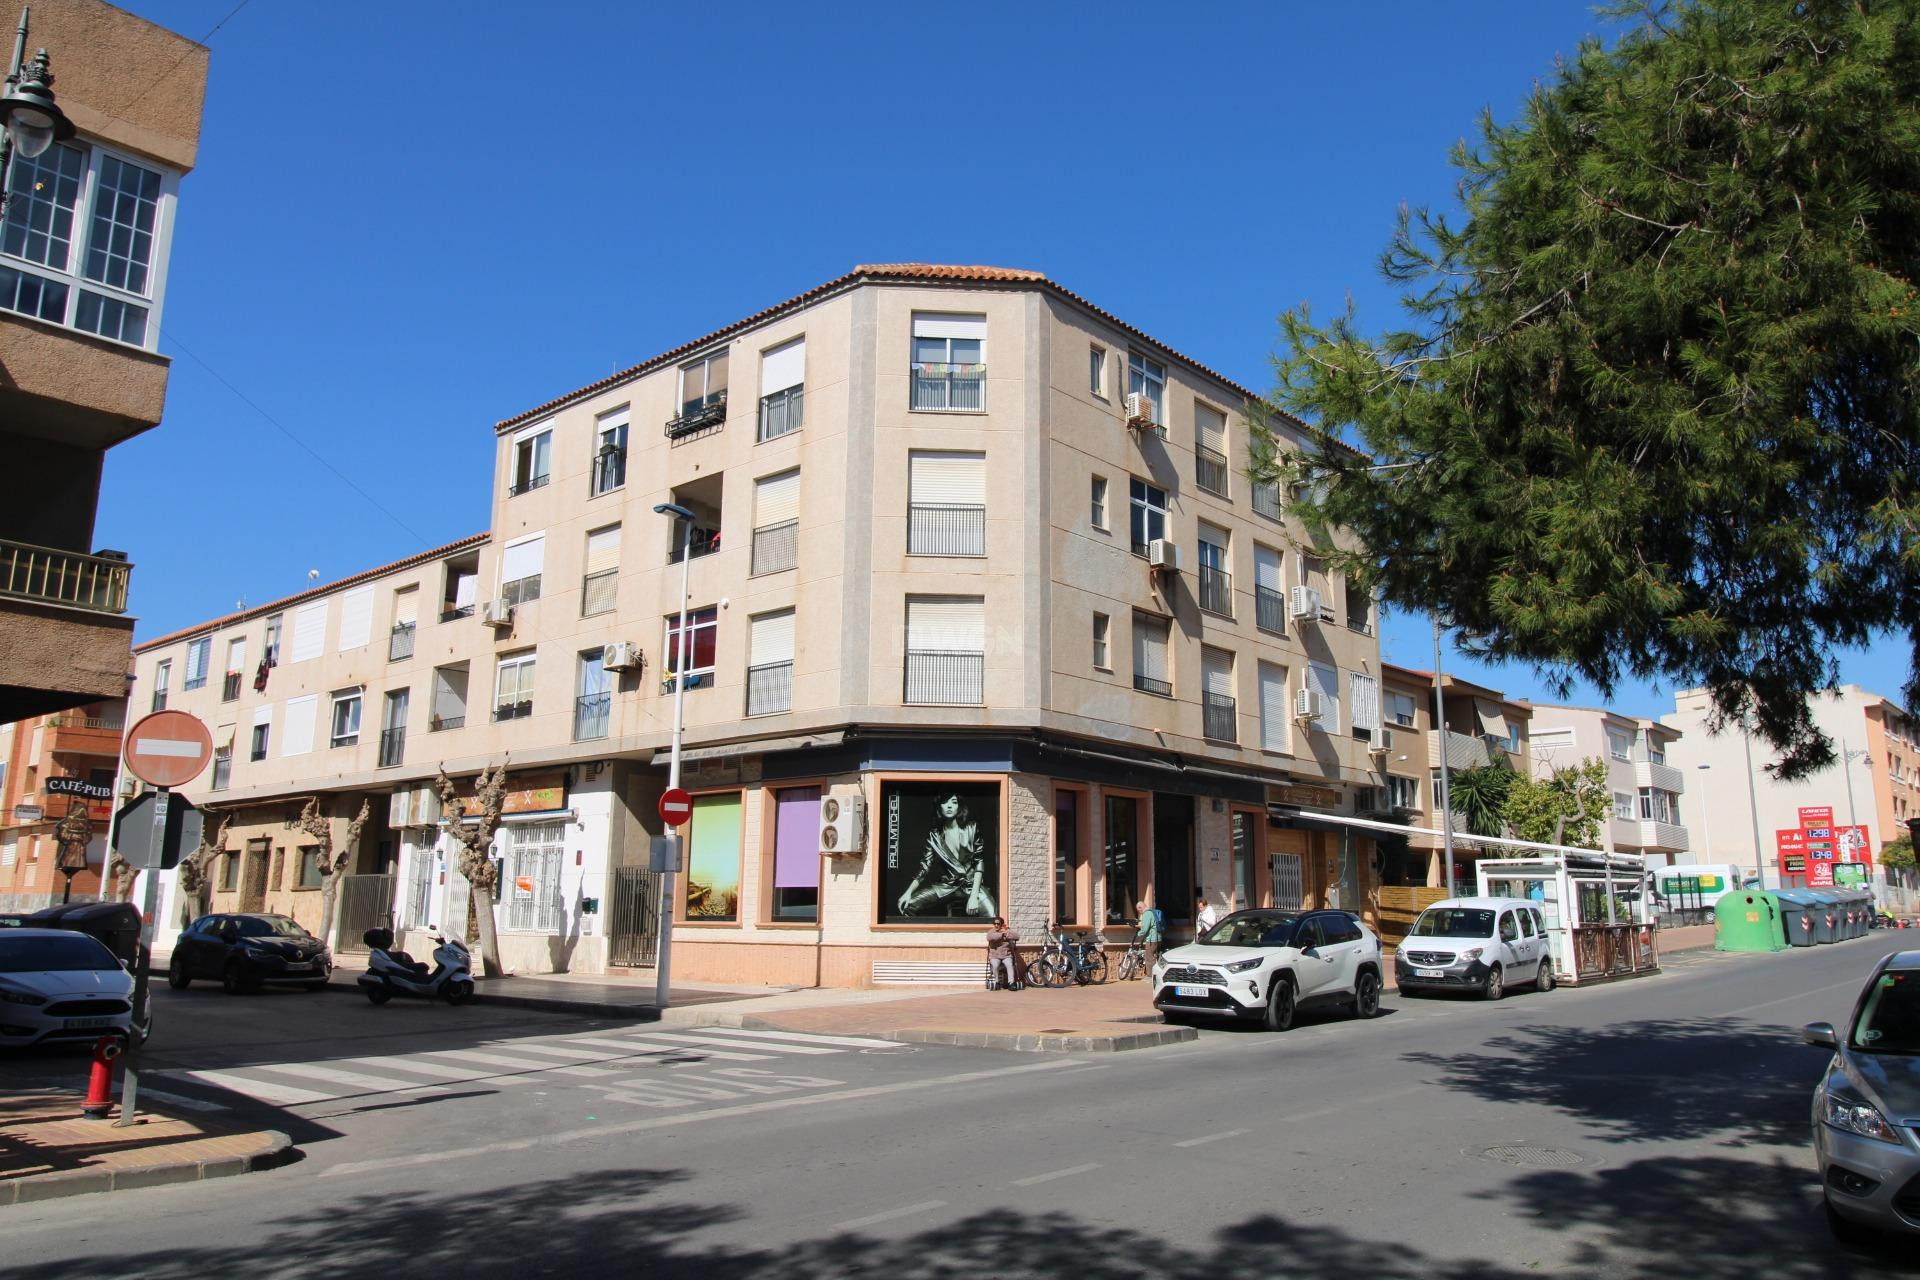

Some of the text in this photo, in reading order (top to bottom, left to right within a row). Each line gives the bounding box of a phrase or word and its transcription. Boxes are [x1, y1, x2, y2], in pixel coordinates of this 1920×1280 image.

[49, 780, 111, 797] CAFÉ-PUB
[889, 841, 898, 868] PAUL
[578, 1066, 848, 1108] STOP
